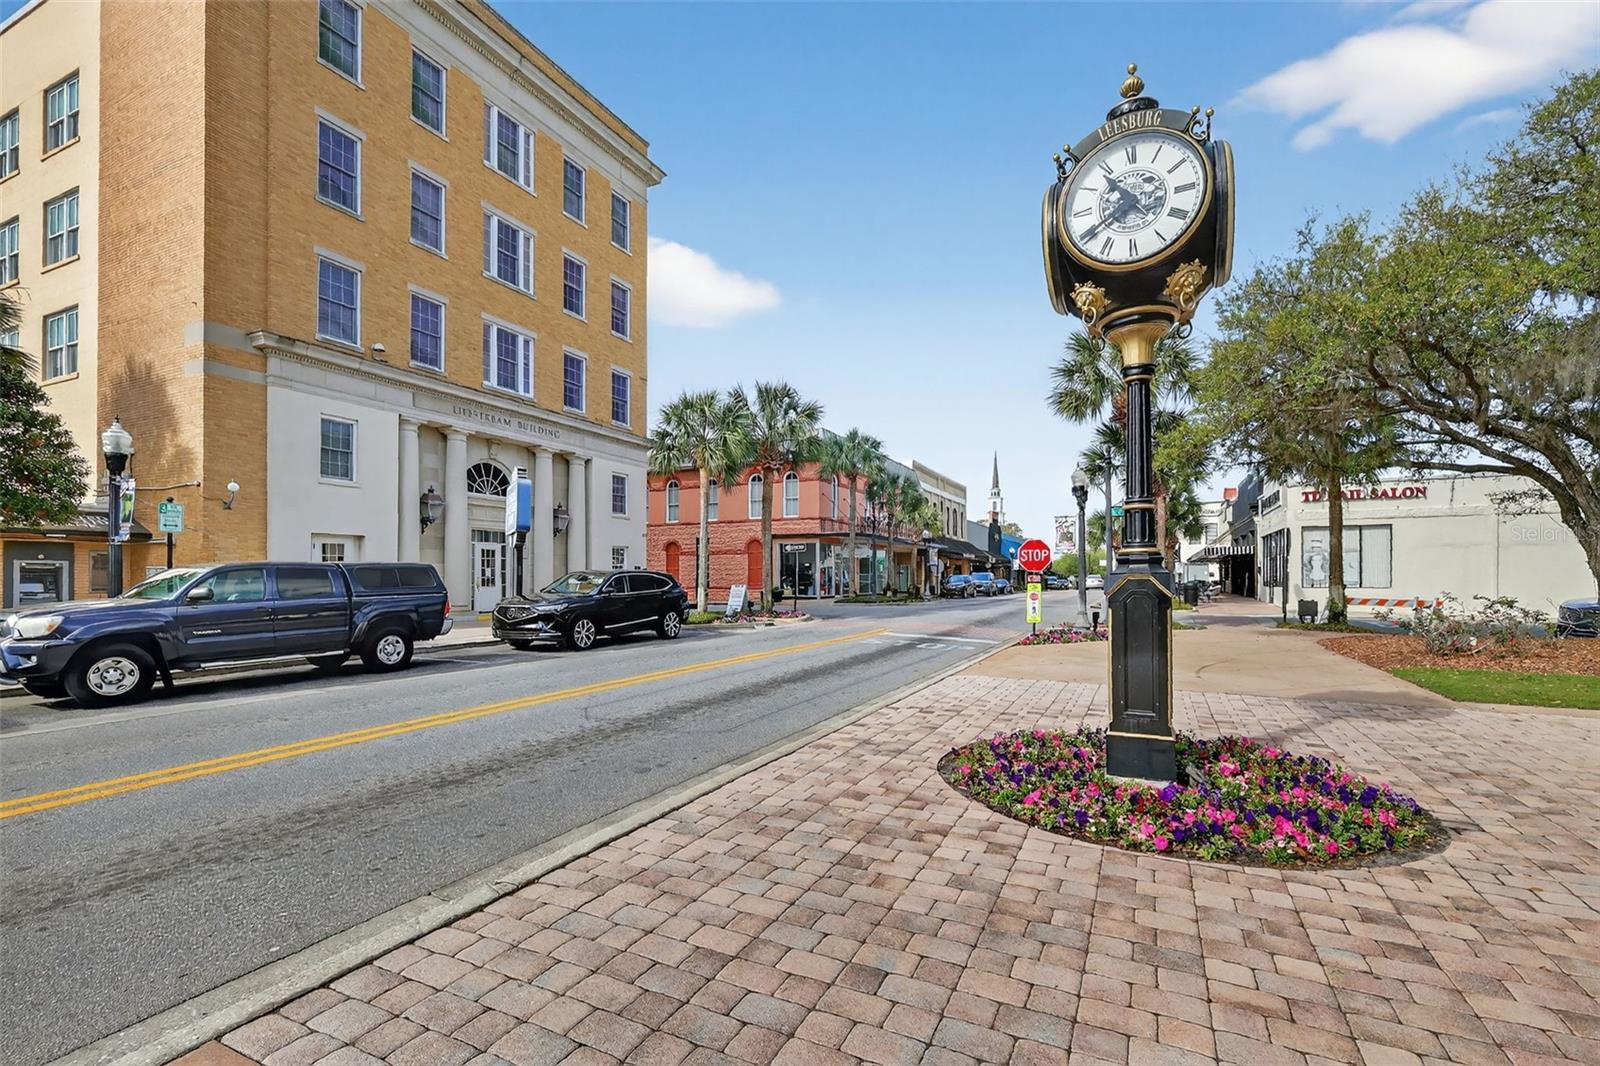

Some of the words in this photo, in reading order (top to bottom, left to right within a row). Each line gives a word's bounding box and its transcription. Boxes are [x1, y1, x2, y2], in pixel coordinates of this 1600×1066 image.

[1097, 110, 1163, 142] LEESBURG
[1174, 182, 1196, 194] III
[517, 421, 561, 439] BUILDING
[1370, 486, 1428, 500] SALON
[1020, 549, 1049, 562] STOP
